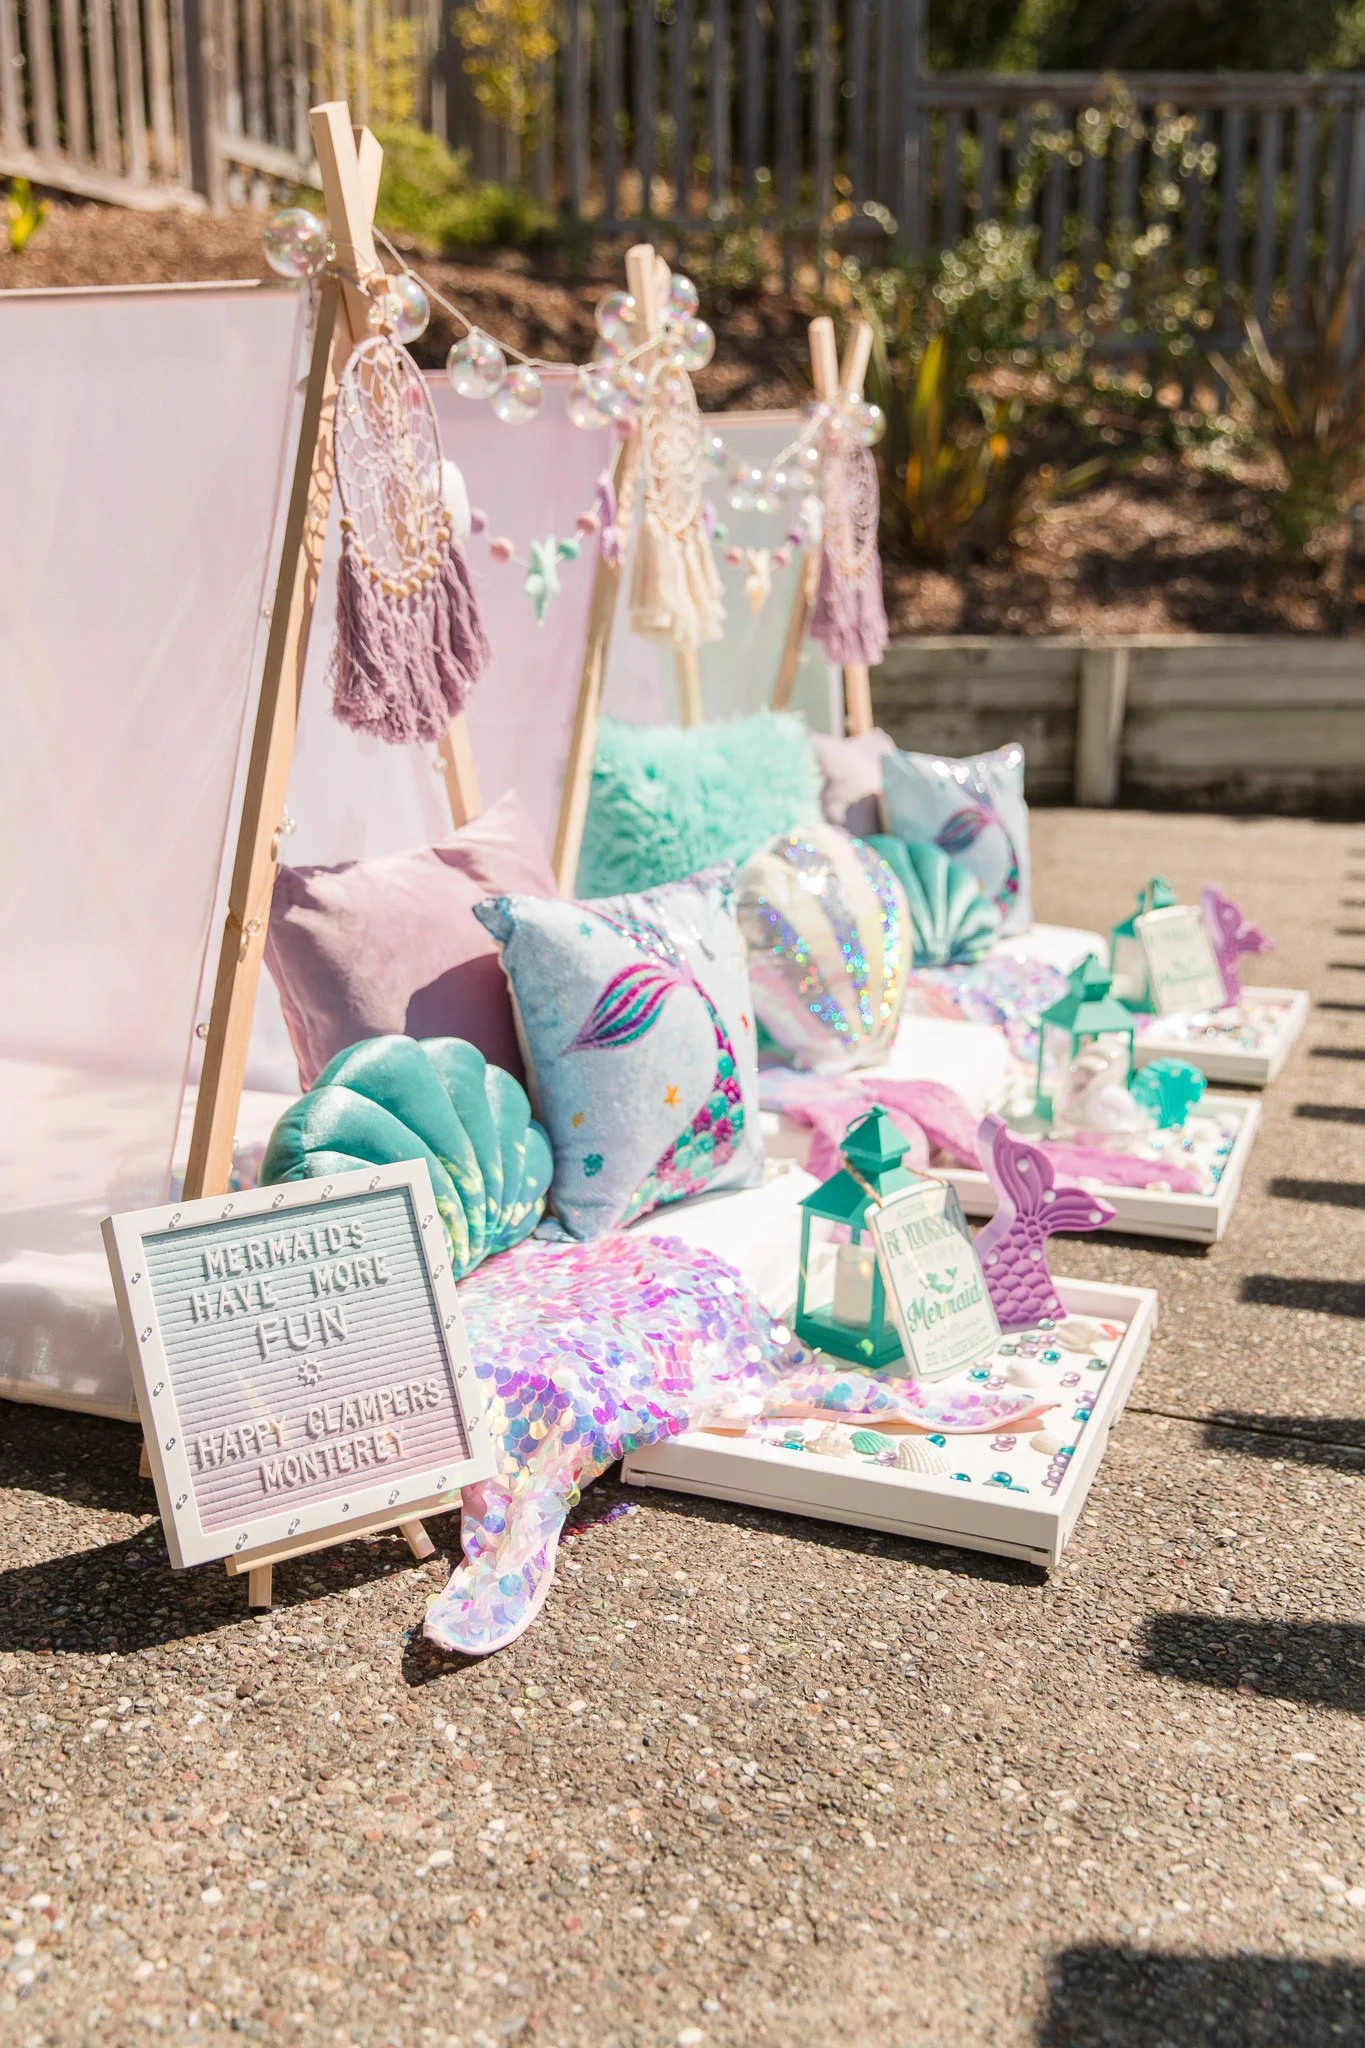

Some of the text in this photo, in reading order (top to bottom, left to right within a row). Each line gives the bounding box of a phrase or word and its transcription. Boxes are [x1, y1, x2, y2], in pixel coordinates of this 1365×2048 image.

[202, 1220, 367, 1279] MERMAIDS
[190, 1252, 392, 1322] HAVE MORE
[907, 1272, 982, 1333] Mermaid
[257, 1303, 348, 1358] FUN
[197, 1378, 443, 1469] HAPPY GLAMPERS
[259, 1425, 405, 1492] MONTEREY
